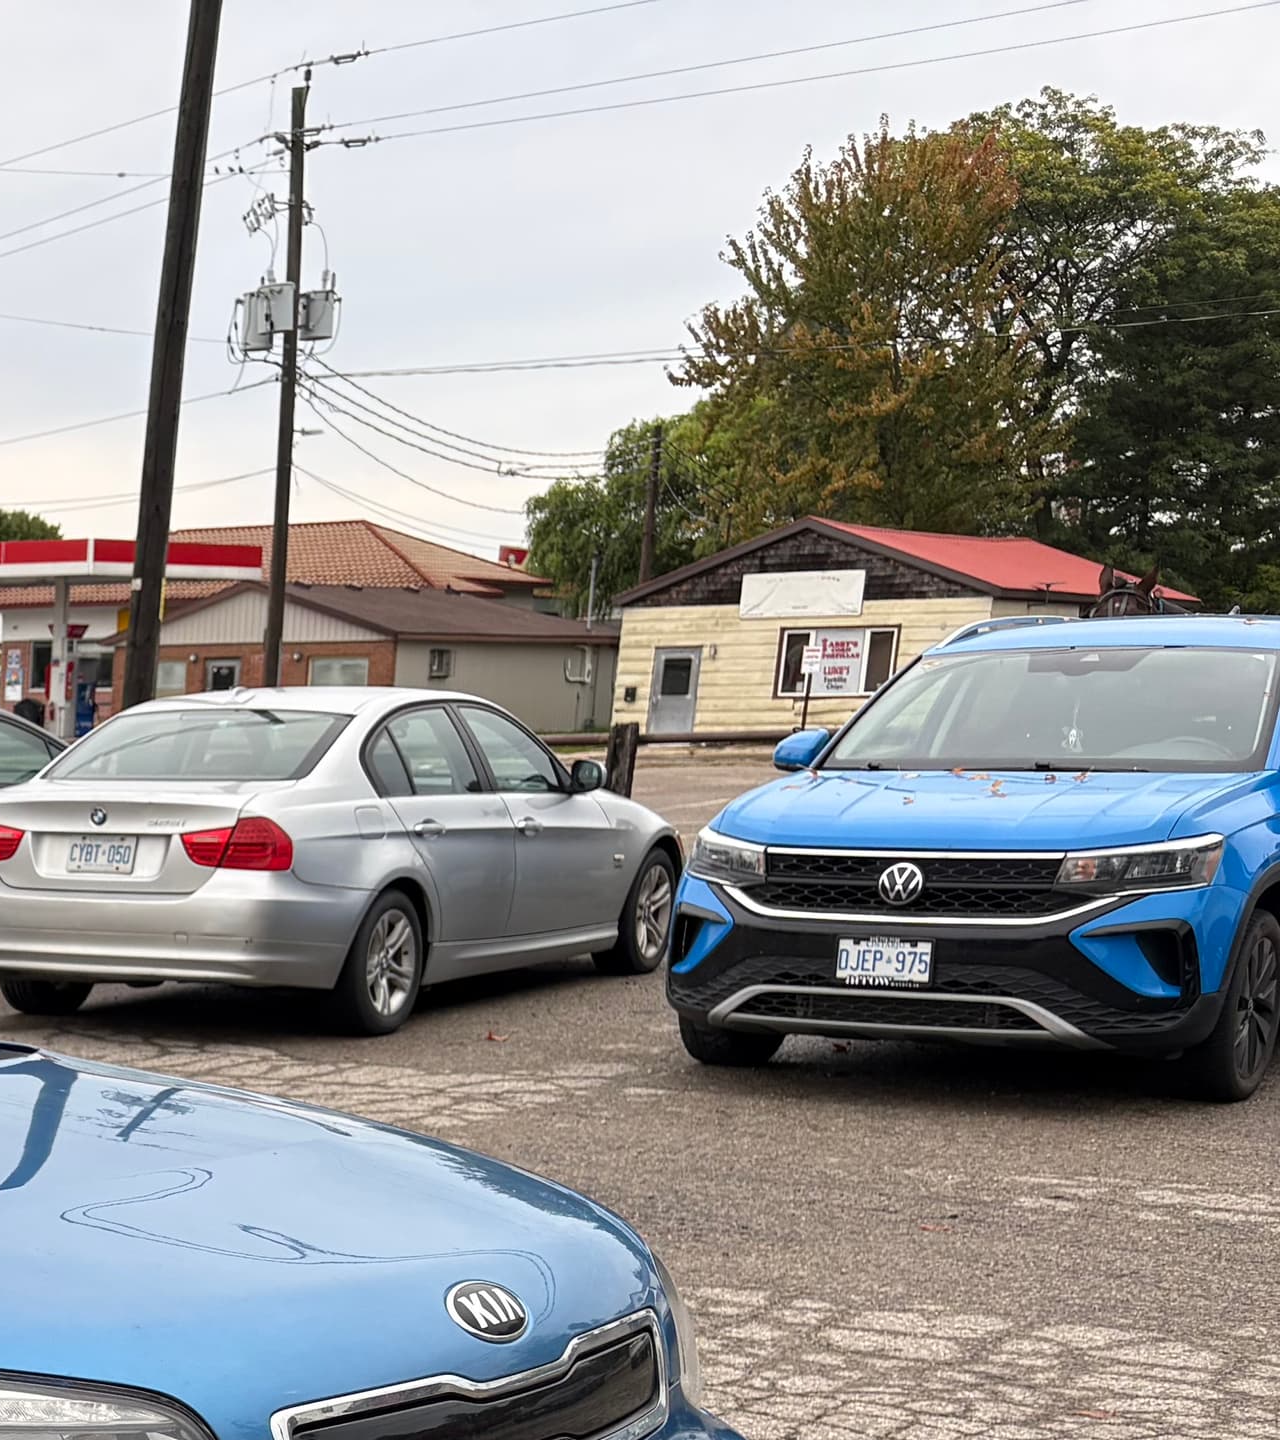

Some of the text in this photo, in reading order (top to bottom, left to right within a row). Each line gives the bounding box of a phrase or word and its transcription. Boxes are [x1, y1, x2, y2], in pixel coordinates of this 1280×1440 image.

[69, 843, 132, 865] CYBT 050
[895, 950, 930, 974] 975
[457, 1287, 525, 1329] KIA
